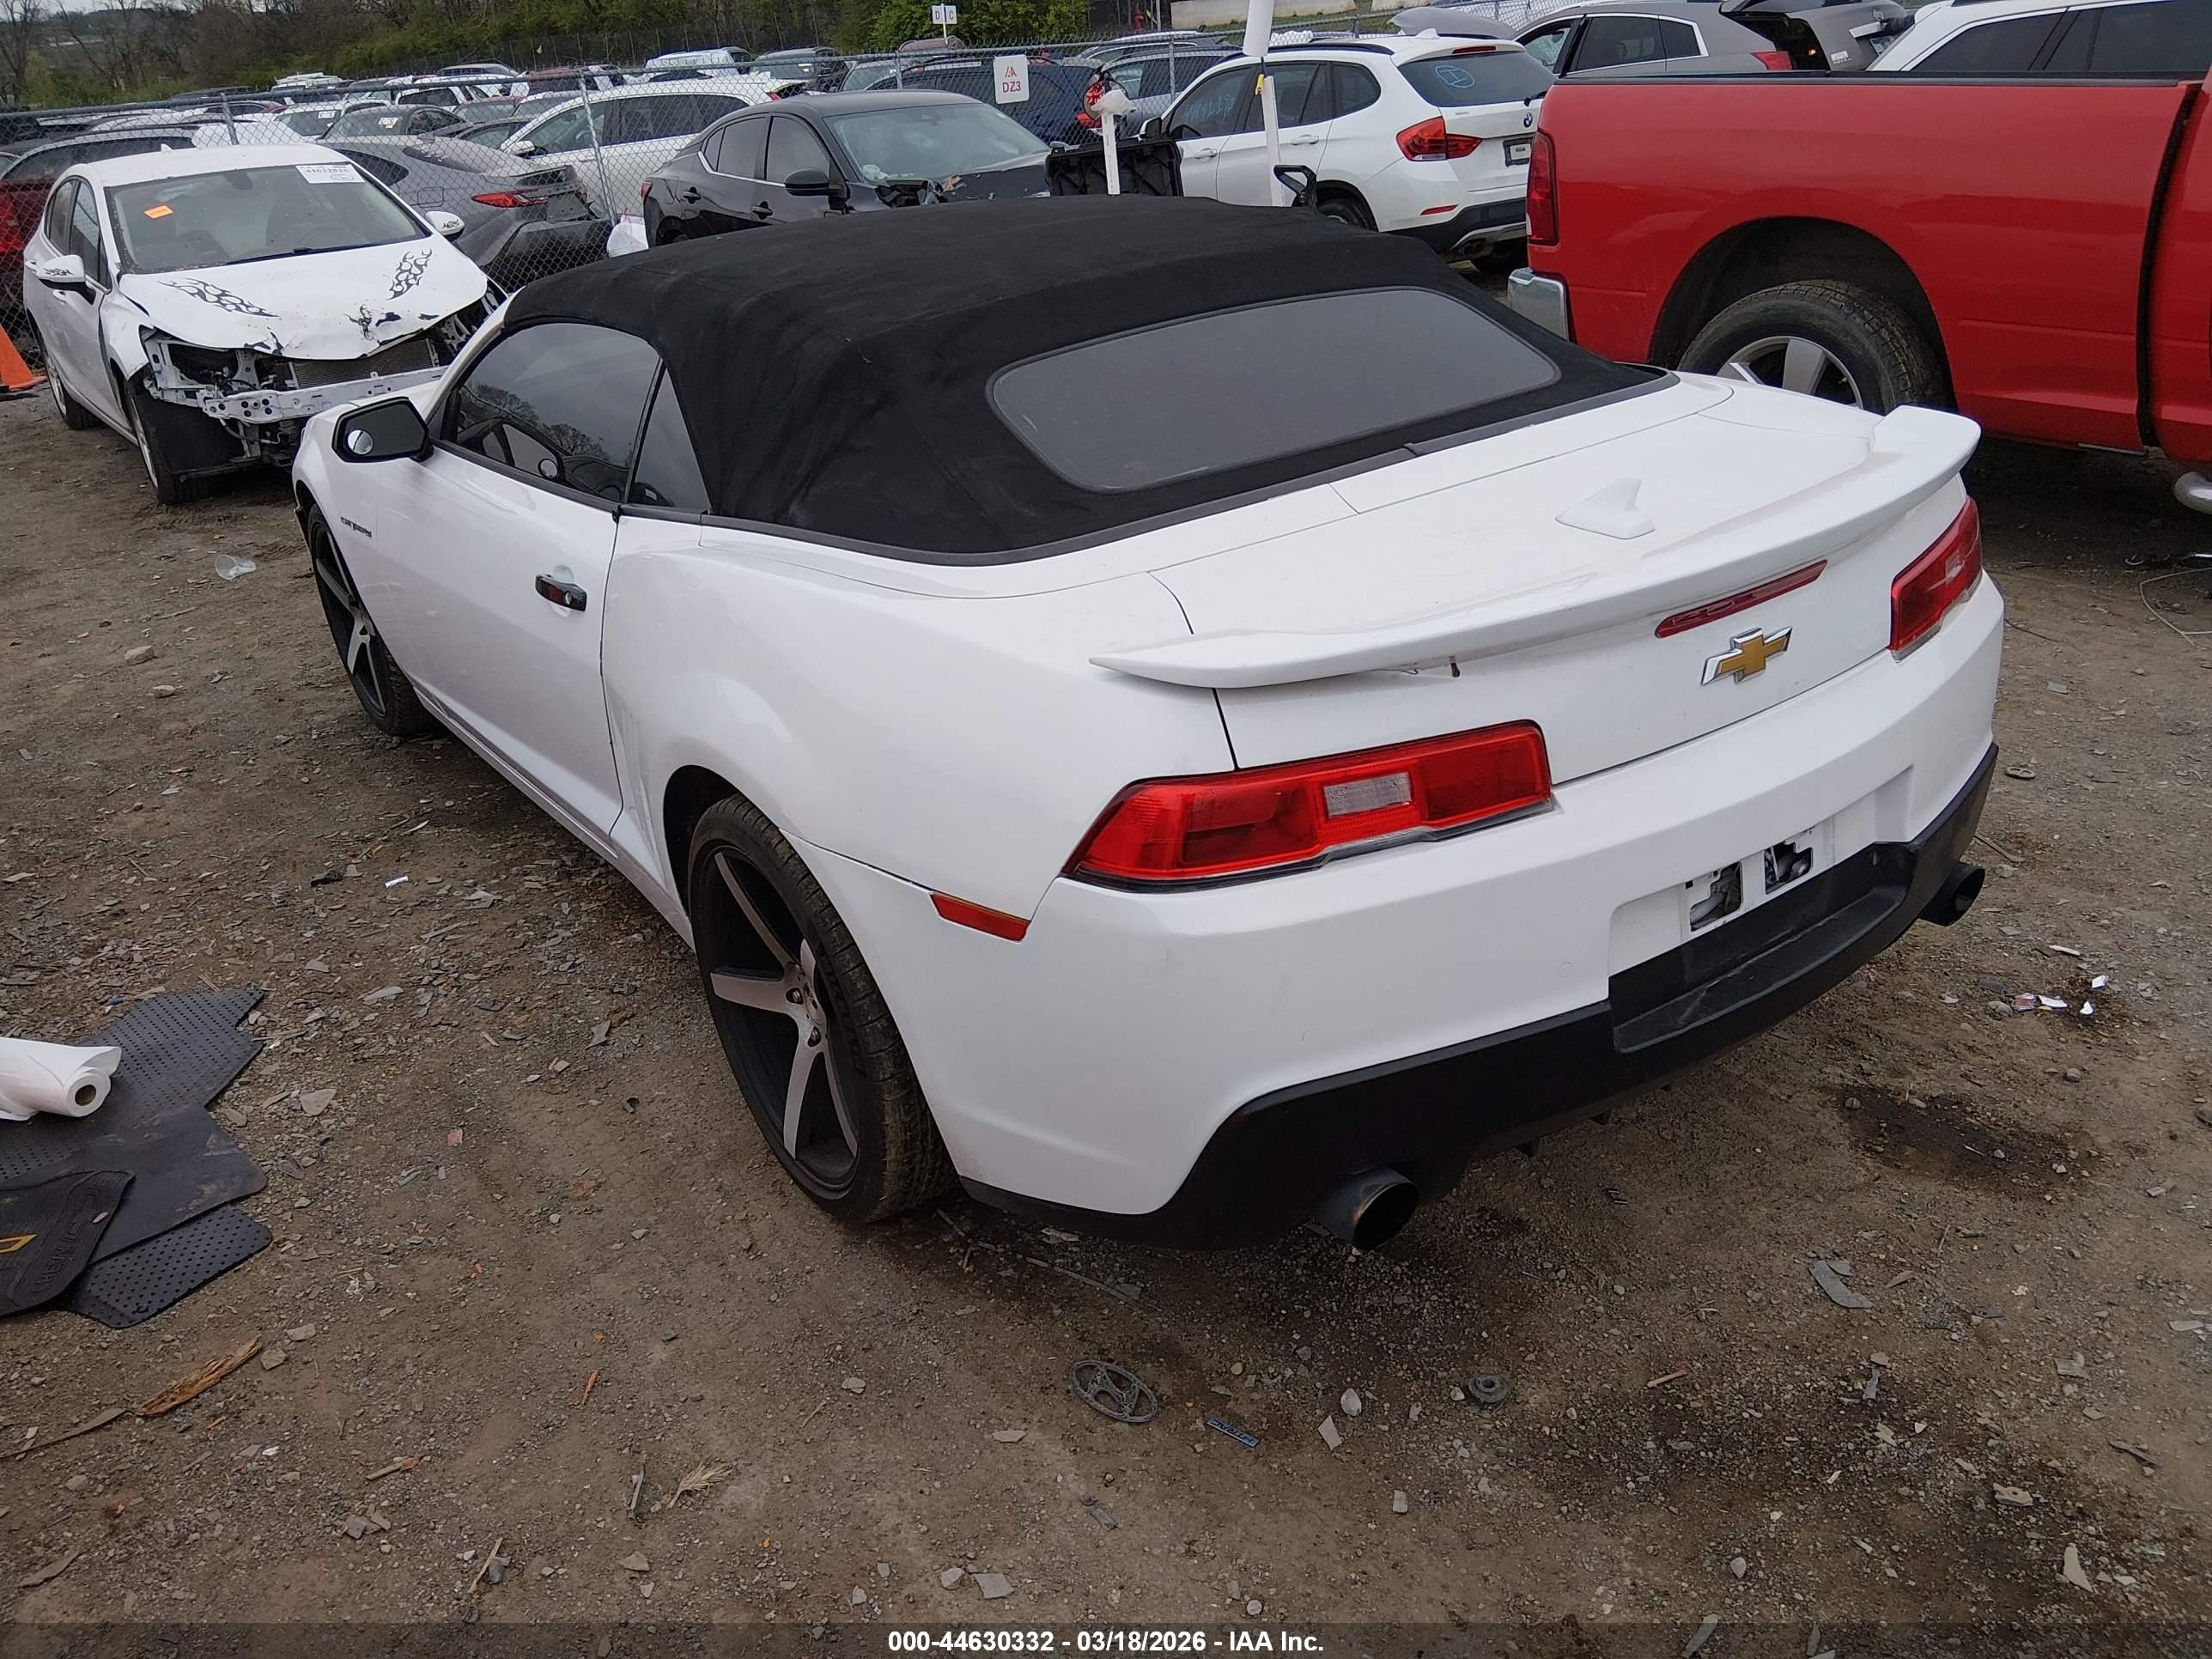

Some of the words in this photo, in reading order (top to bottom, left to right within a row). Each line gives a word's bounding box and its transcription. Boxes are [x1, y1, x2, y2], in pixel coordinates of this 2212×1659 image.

[935, 10, 940, 20] D
[1002, 81, 1022, 93] DZ3
[1210, 1419, 1255, 1443] HTRAC
